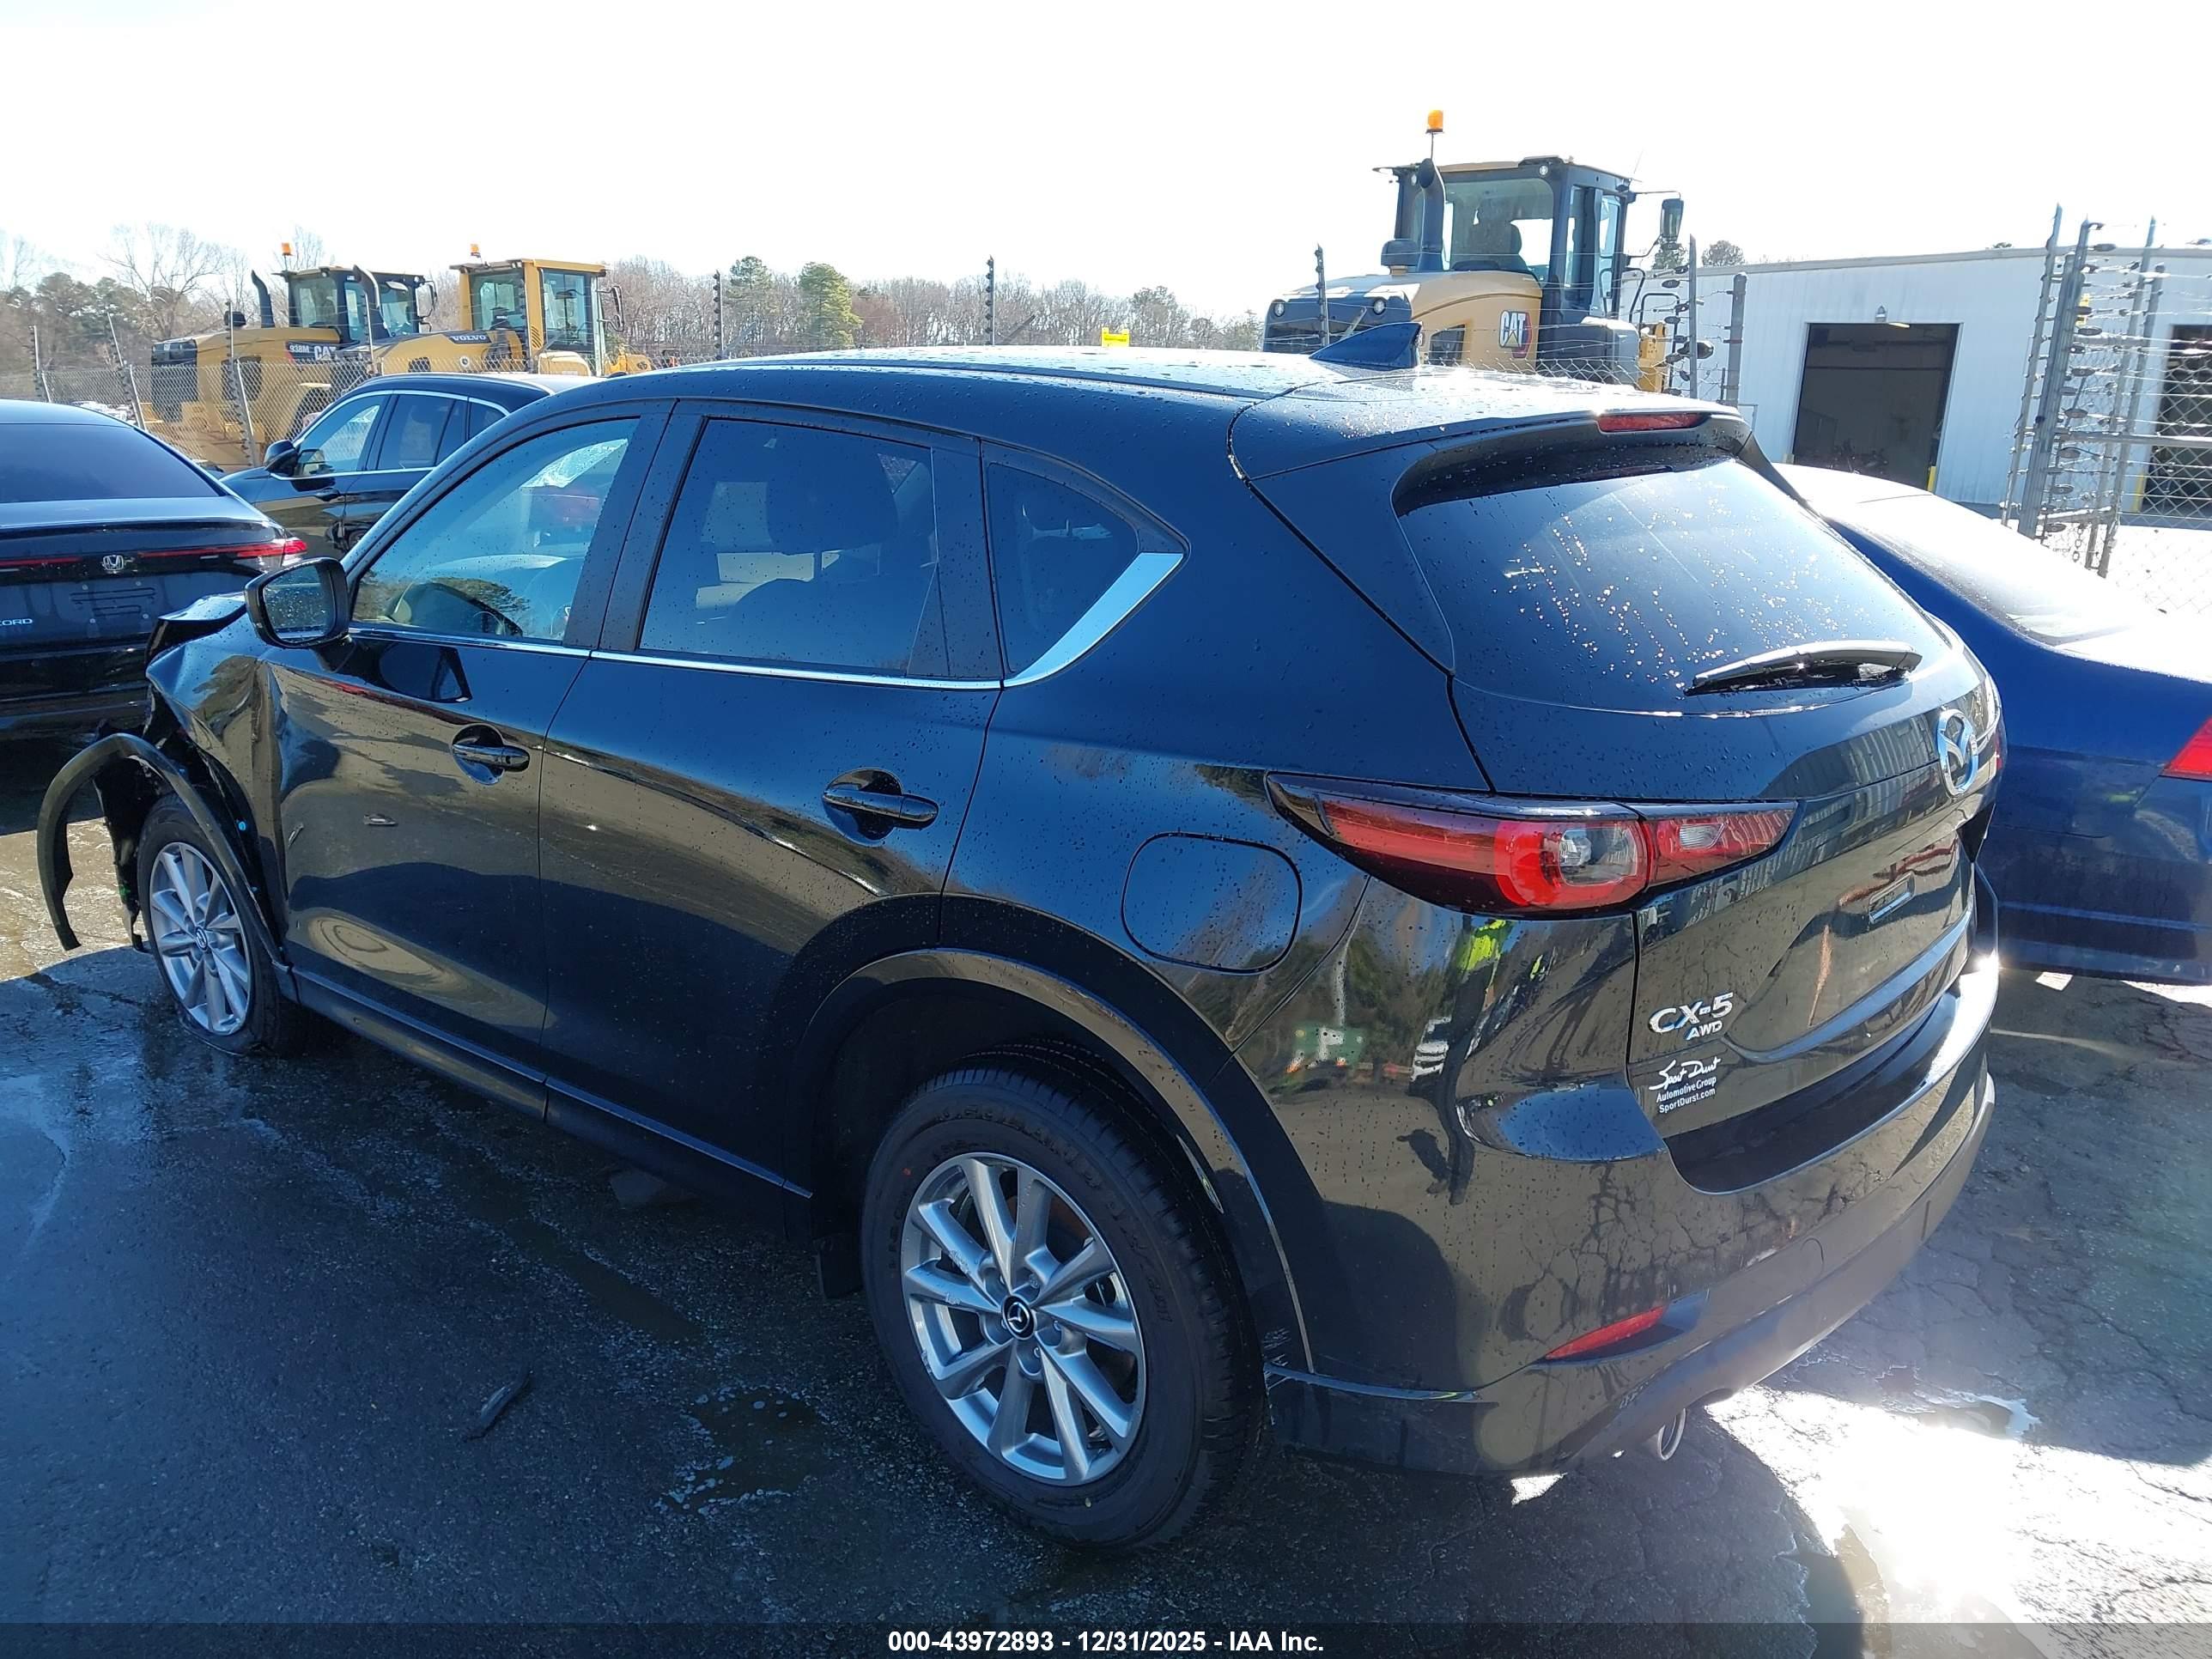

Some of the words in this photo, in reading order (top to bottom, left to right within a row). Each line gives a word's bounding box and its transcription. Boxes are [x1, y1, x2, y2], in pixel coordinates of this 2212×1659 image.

[1500, 311, 1526, 346] CAT
[1648, 992, 1734, 1034] CX-5
[1684, 1020, 1723, 1041] AWD
[1656, 1082, 1696, 1103] Automotive
[1696, 1076, 1717, 1090] Group
[1658, 1087, 1716, 1114] SportDurst.com
